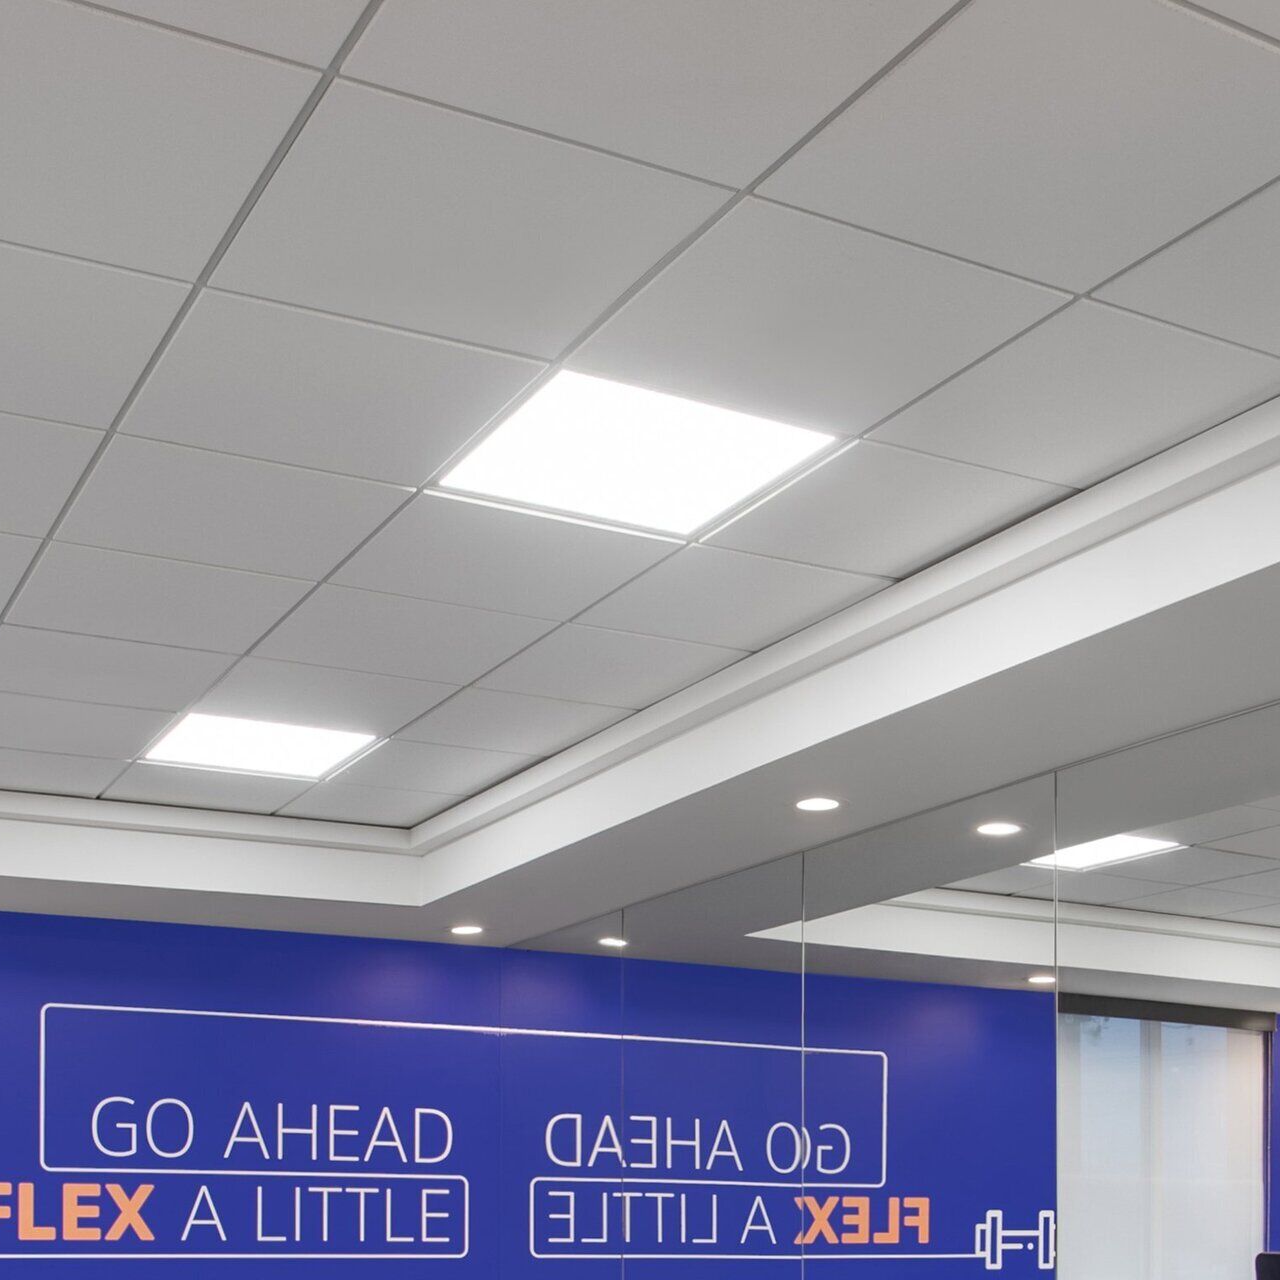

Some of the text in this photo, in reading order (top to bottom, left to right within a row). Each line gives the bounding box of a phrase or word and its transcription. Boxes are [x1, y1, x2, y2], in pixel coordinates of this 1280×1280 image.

[91, 1096, 453, 1164] GO AHEAD
[180, 1185, 227, 1242] A
[256, 1185, 450, 1243] LITTLE
